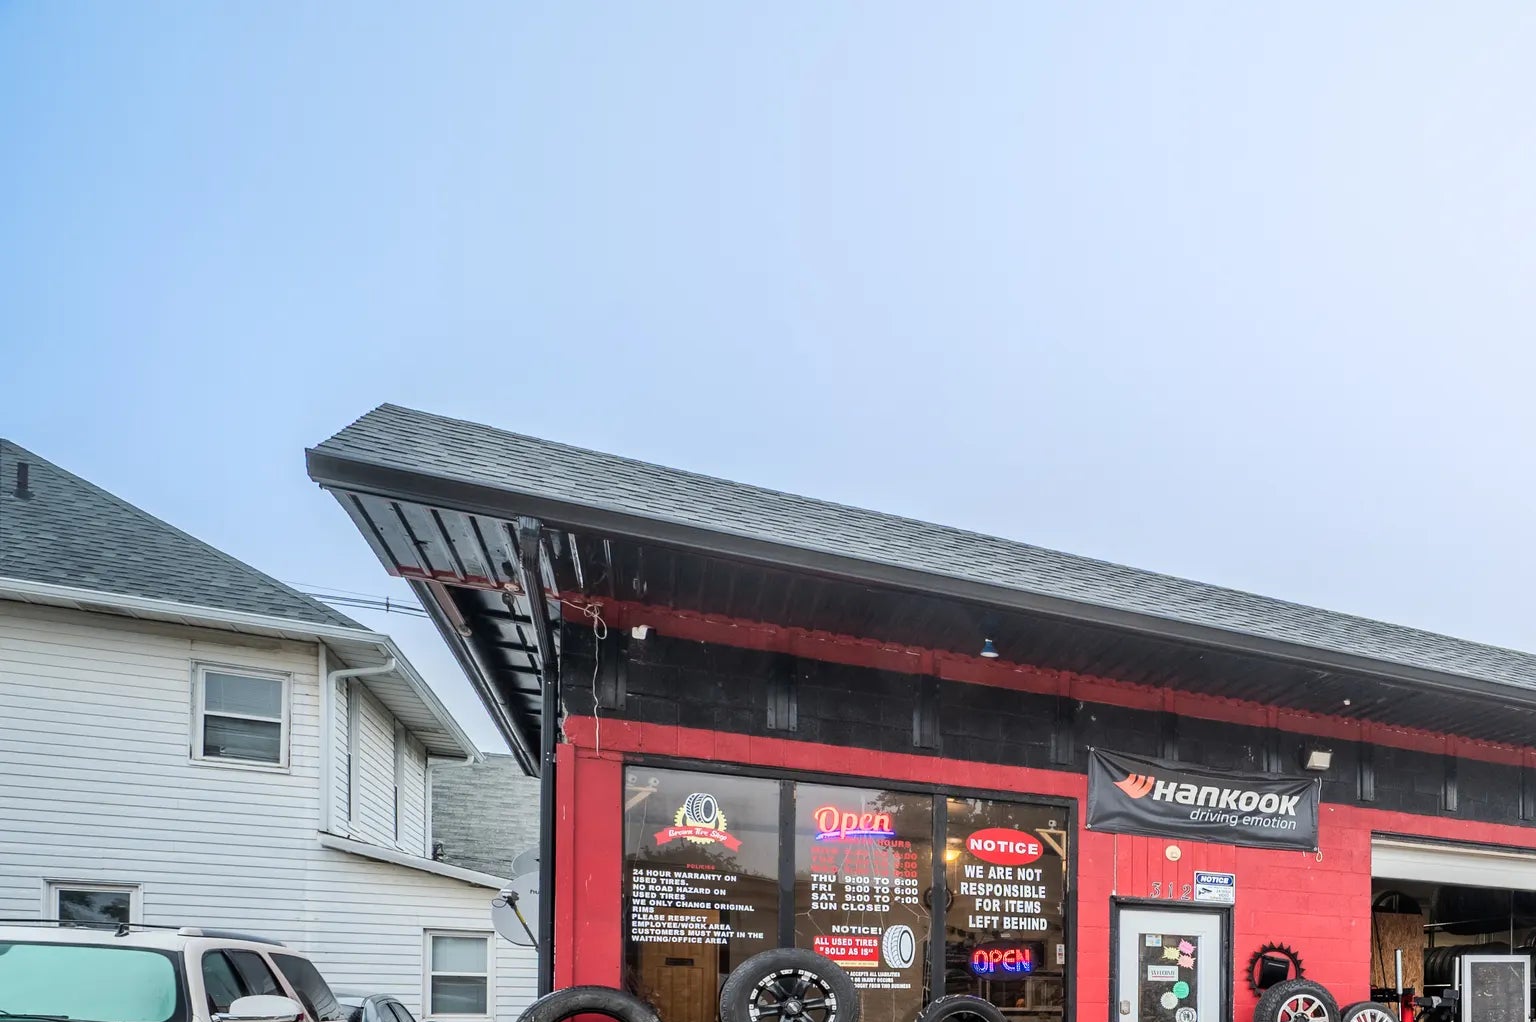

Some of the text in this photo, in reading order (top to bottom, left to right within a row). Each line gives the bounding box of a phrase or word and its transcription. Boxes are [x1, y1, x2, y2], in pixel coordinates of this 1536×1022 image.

[814, 806, 891, 840] Open
[1190, 808, 1297, 830] driving emotion
[970, 838, 1039, 855] NOTICE
[632, 868, 644, 876] 24
[646, 869, 671, 878] HOUR
[674, 871, 722, 881] WARRANTY
[964, 864, 1042, 882] WE ARE NOT
[632, 876, 689, 886] USED TIRES.
[811, 874, 836, 882] THU
[844, 876, 870, 884] 9:00
[1200, 876, 1229, 884] NOTICE
[648, 884, 673, 892] ROAD
[676, 886, 711, 895] HAZARD
[812, 884, 832, 892] FRI
[844, 885, 870, 893] 9:00
[874, 886, 890, 894] TO
[960, 882, 1046, 898] RESPONSIBLE
[1150, 882, 1192, 900] 312
[632, 891, 657, 899] USED
[812, 893, 836, 901] SAT
[844, 894, 870, 902] 9:00
[874, 895, 890, 903] TO
[632, 898, 755, 912] WE ONLY CHANGE ORIGINAL
[812, 902, 890, 912] SUN CLOSED
[975, 898, 1041, 914] FOR ITEMS
[632, 921, 707, 929] EMPLOYEE/WORK
[969, 915, 1047, 930] LEFT BEHIND
[632, 928, 685, 936] CUSTOMERS
[832, 925, 882, 935] NOTICE!
[632, 935, 702, 944] WAITING/OFFICE
[832, 938, 853, 946] USED
[855, 939, 878, 947] TIRES
[974, 949, 1031, 973] OPEN
